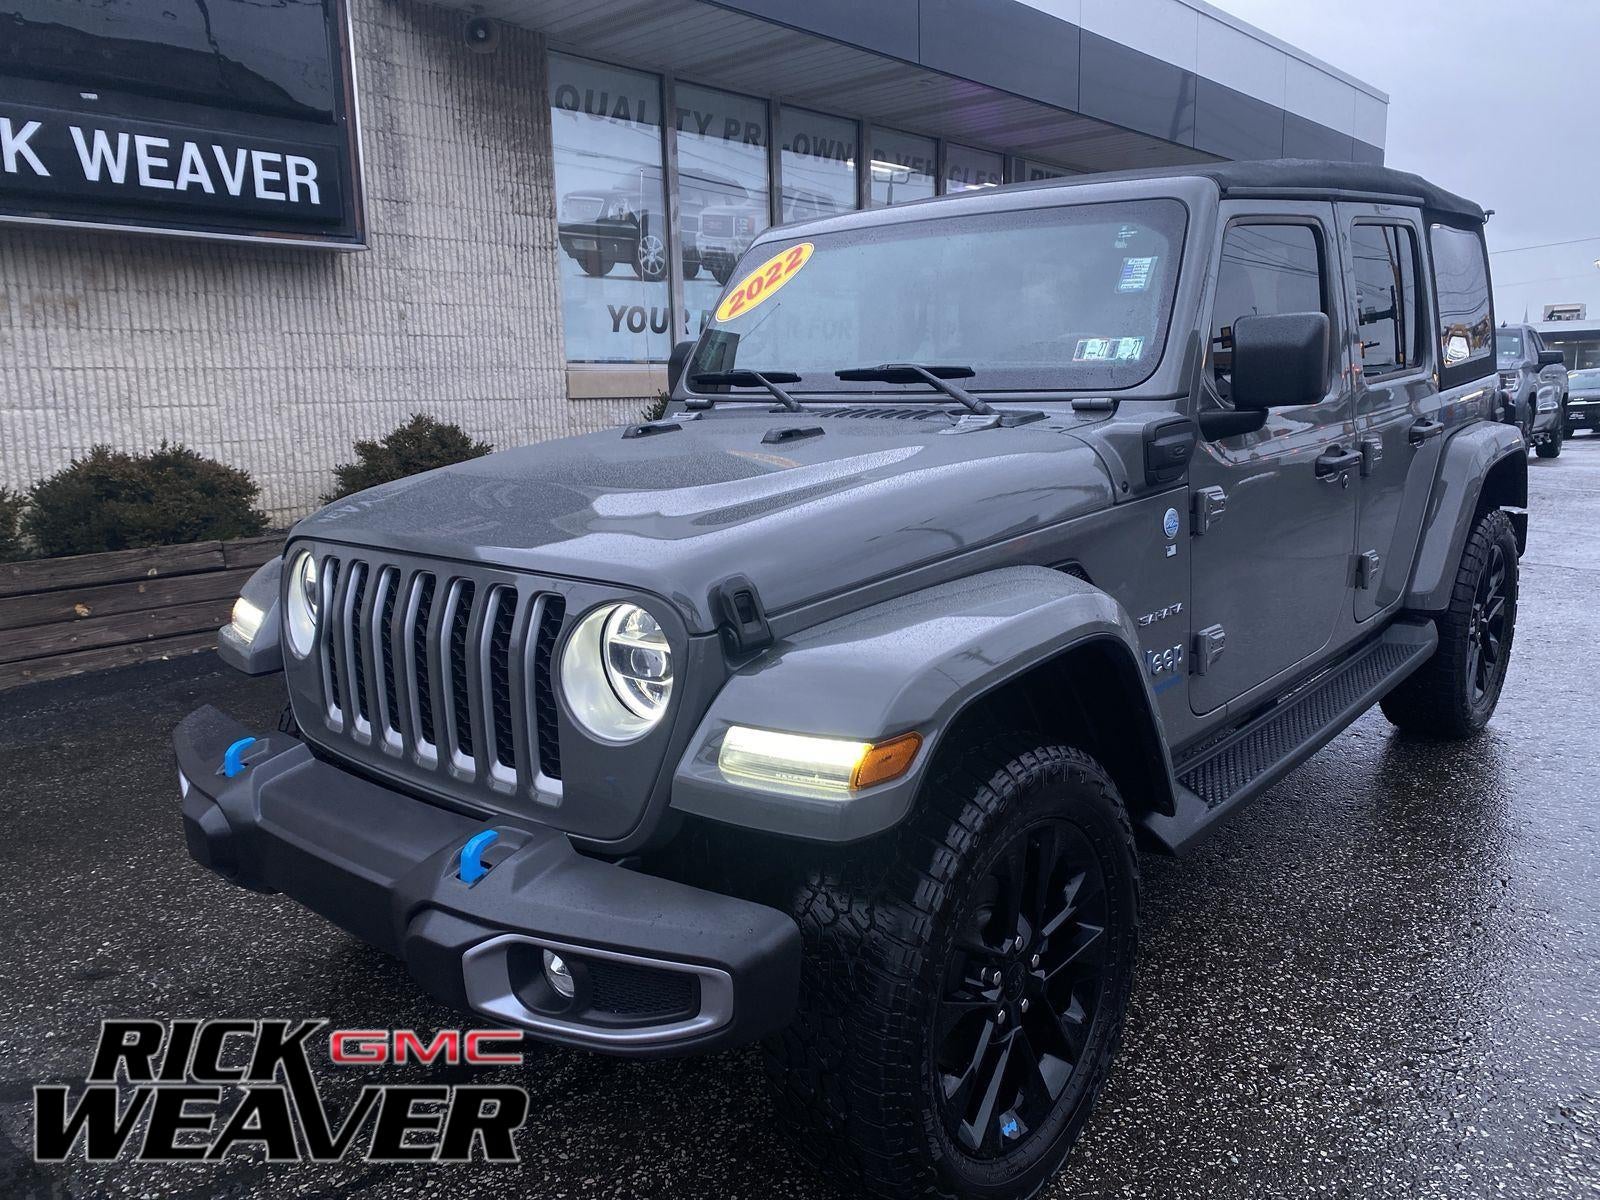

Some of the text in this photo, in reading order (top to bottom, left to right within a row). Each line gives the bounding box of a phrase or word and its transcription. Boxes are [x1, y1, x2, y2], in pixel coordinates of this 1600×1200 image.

[0, 117, 321, 205] K WEAVER
[555, 84, 714, 141] QUALTY
[896, 152, 1000, 187] VEHCLES
[728, 246, 803, 318] 2022
[1146, 644, 1184, 676] Jeep
